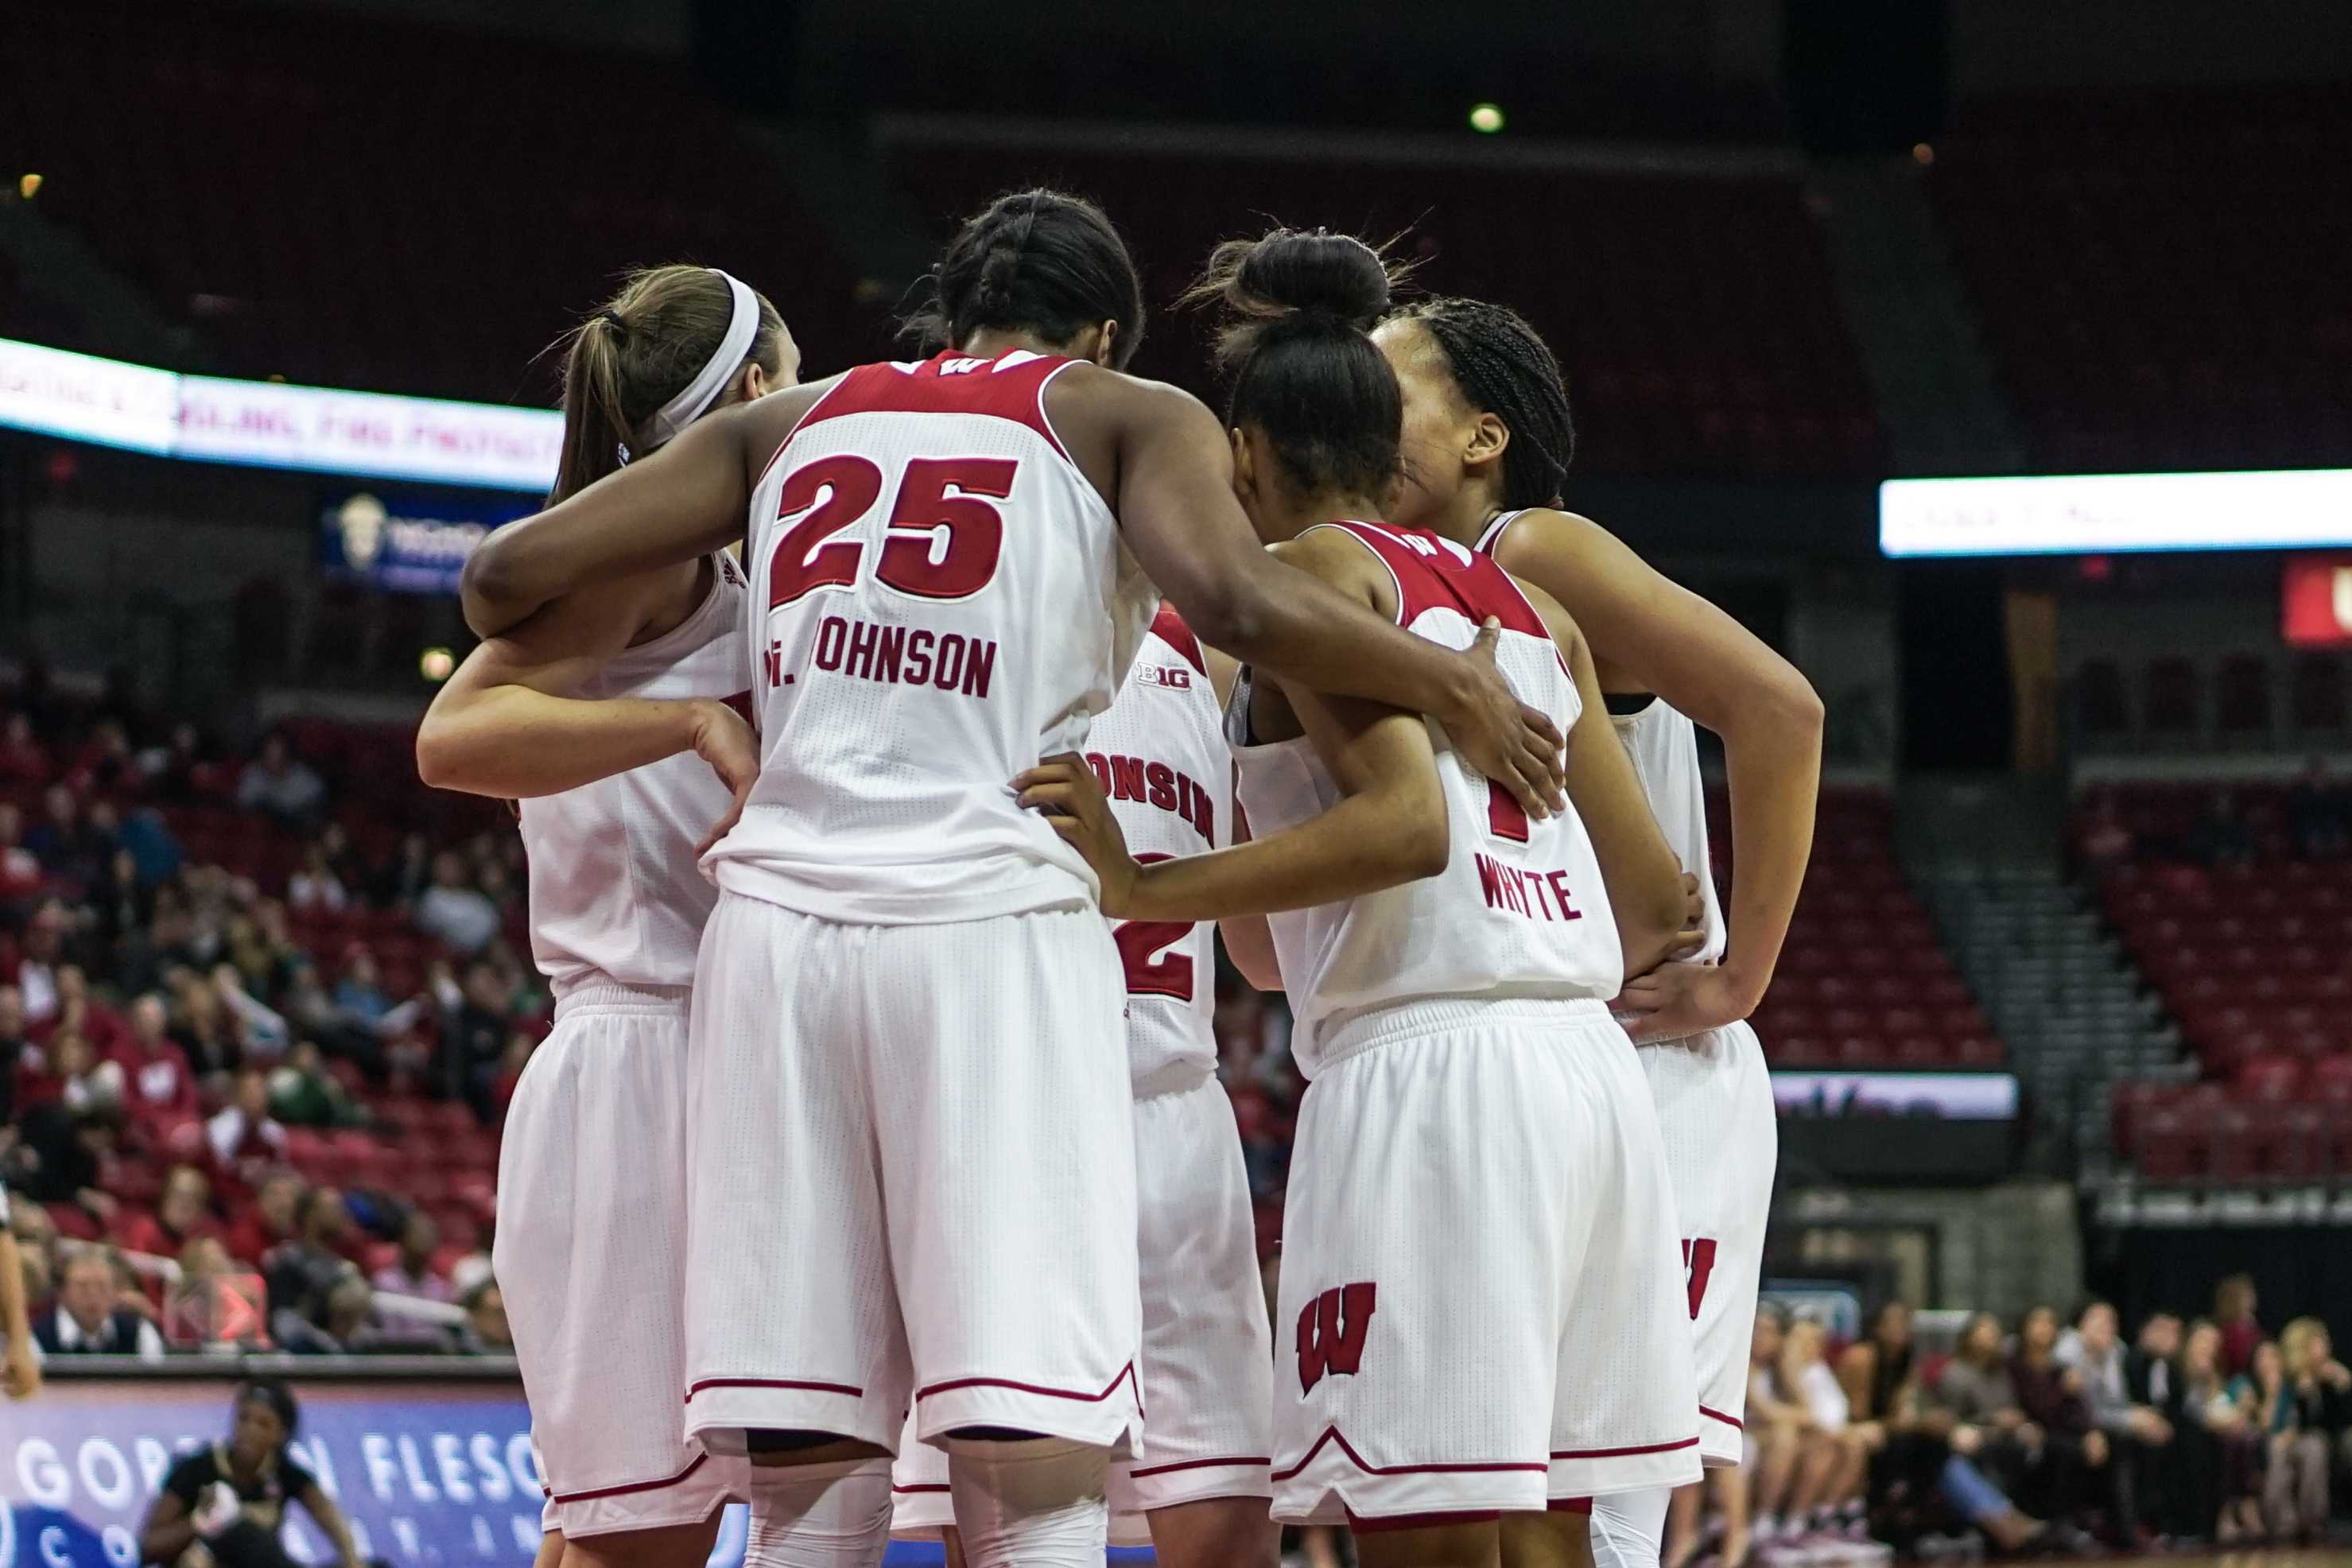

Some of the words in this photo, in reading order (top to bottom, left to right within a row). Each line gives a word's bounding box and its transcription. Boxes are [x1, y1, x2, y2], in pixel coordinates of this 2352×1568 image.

[769, 454, 1019, 611] 25
[811, 616, 997, 698] OHNSON
[1475, 852, 1582, 922] WHYTE
[1296, 1281, 1376, 1399] W
